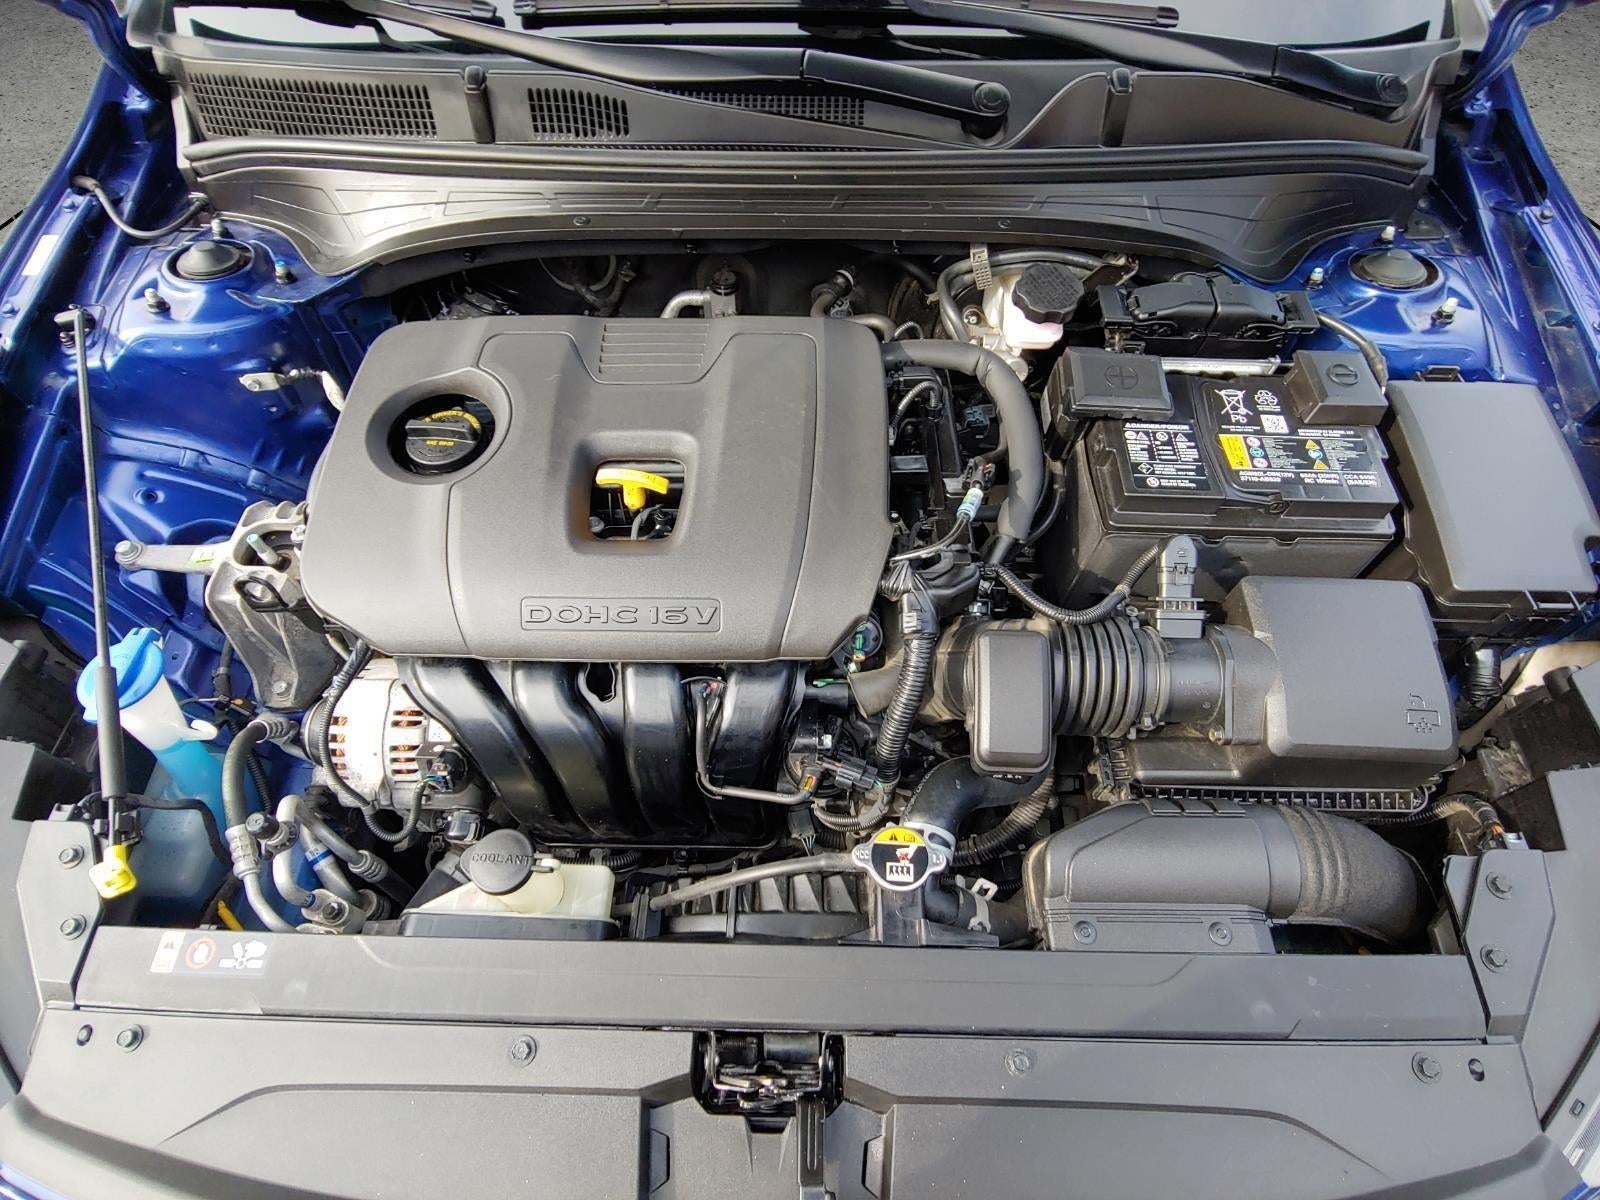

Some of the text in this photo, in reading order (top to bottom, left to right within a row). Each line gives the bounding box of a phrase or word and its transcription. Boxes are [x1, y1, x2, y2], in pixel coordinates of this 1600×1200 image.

[1231, 414, 1248, 423] Pb
[524, 605, 638, 624] DOHC
[471, 852, 532, 866] COOLANT
